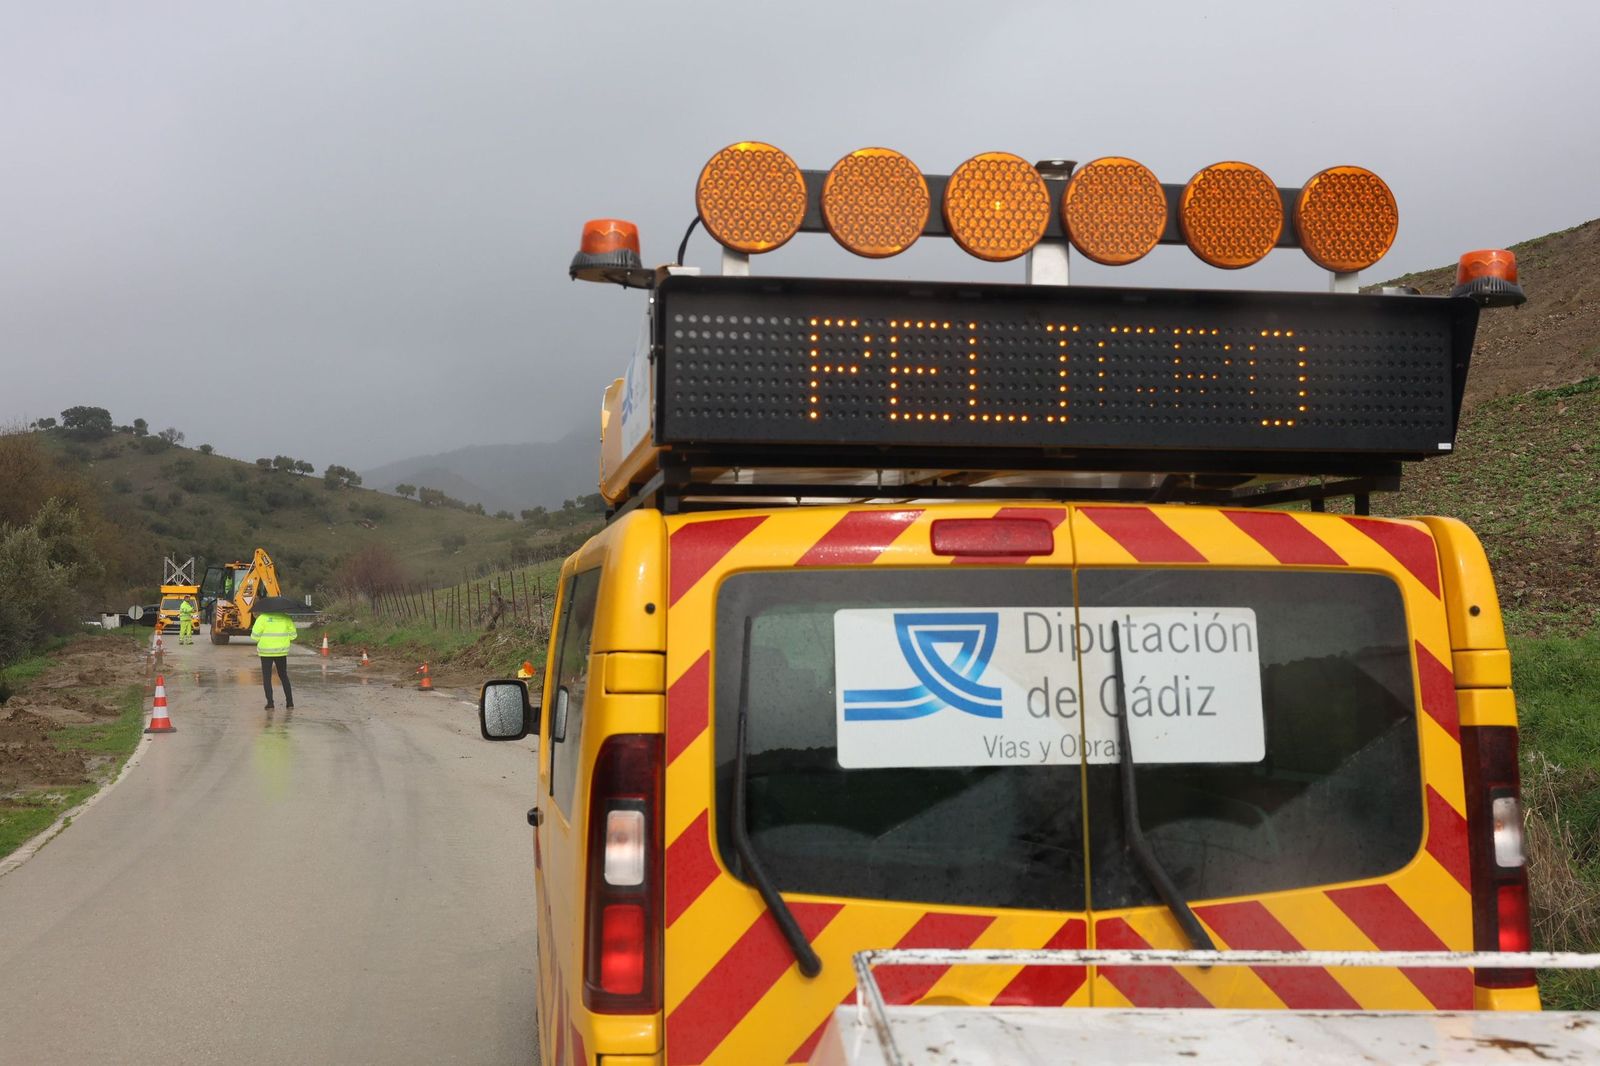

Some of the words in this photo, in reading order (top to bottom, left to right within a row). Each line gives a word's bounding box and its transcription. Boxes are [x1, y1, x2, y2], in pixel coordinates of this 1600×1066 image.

[1023, 611, 1253, 661] Diputación
[1027, 676, 1078, 718] de
[1100, 675, 1217, 718] Cádiz
[983, 735, 1031, 758] Vías
[1039, 741, 1051, 763] y
